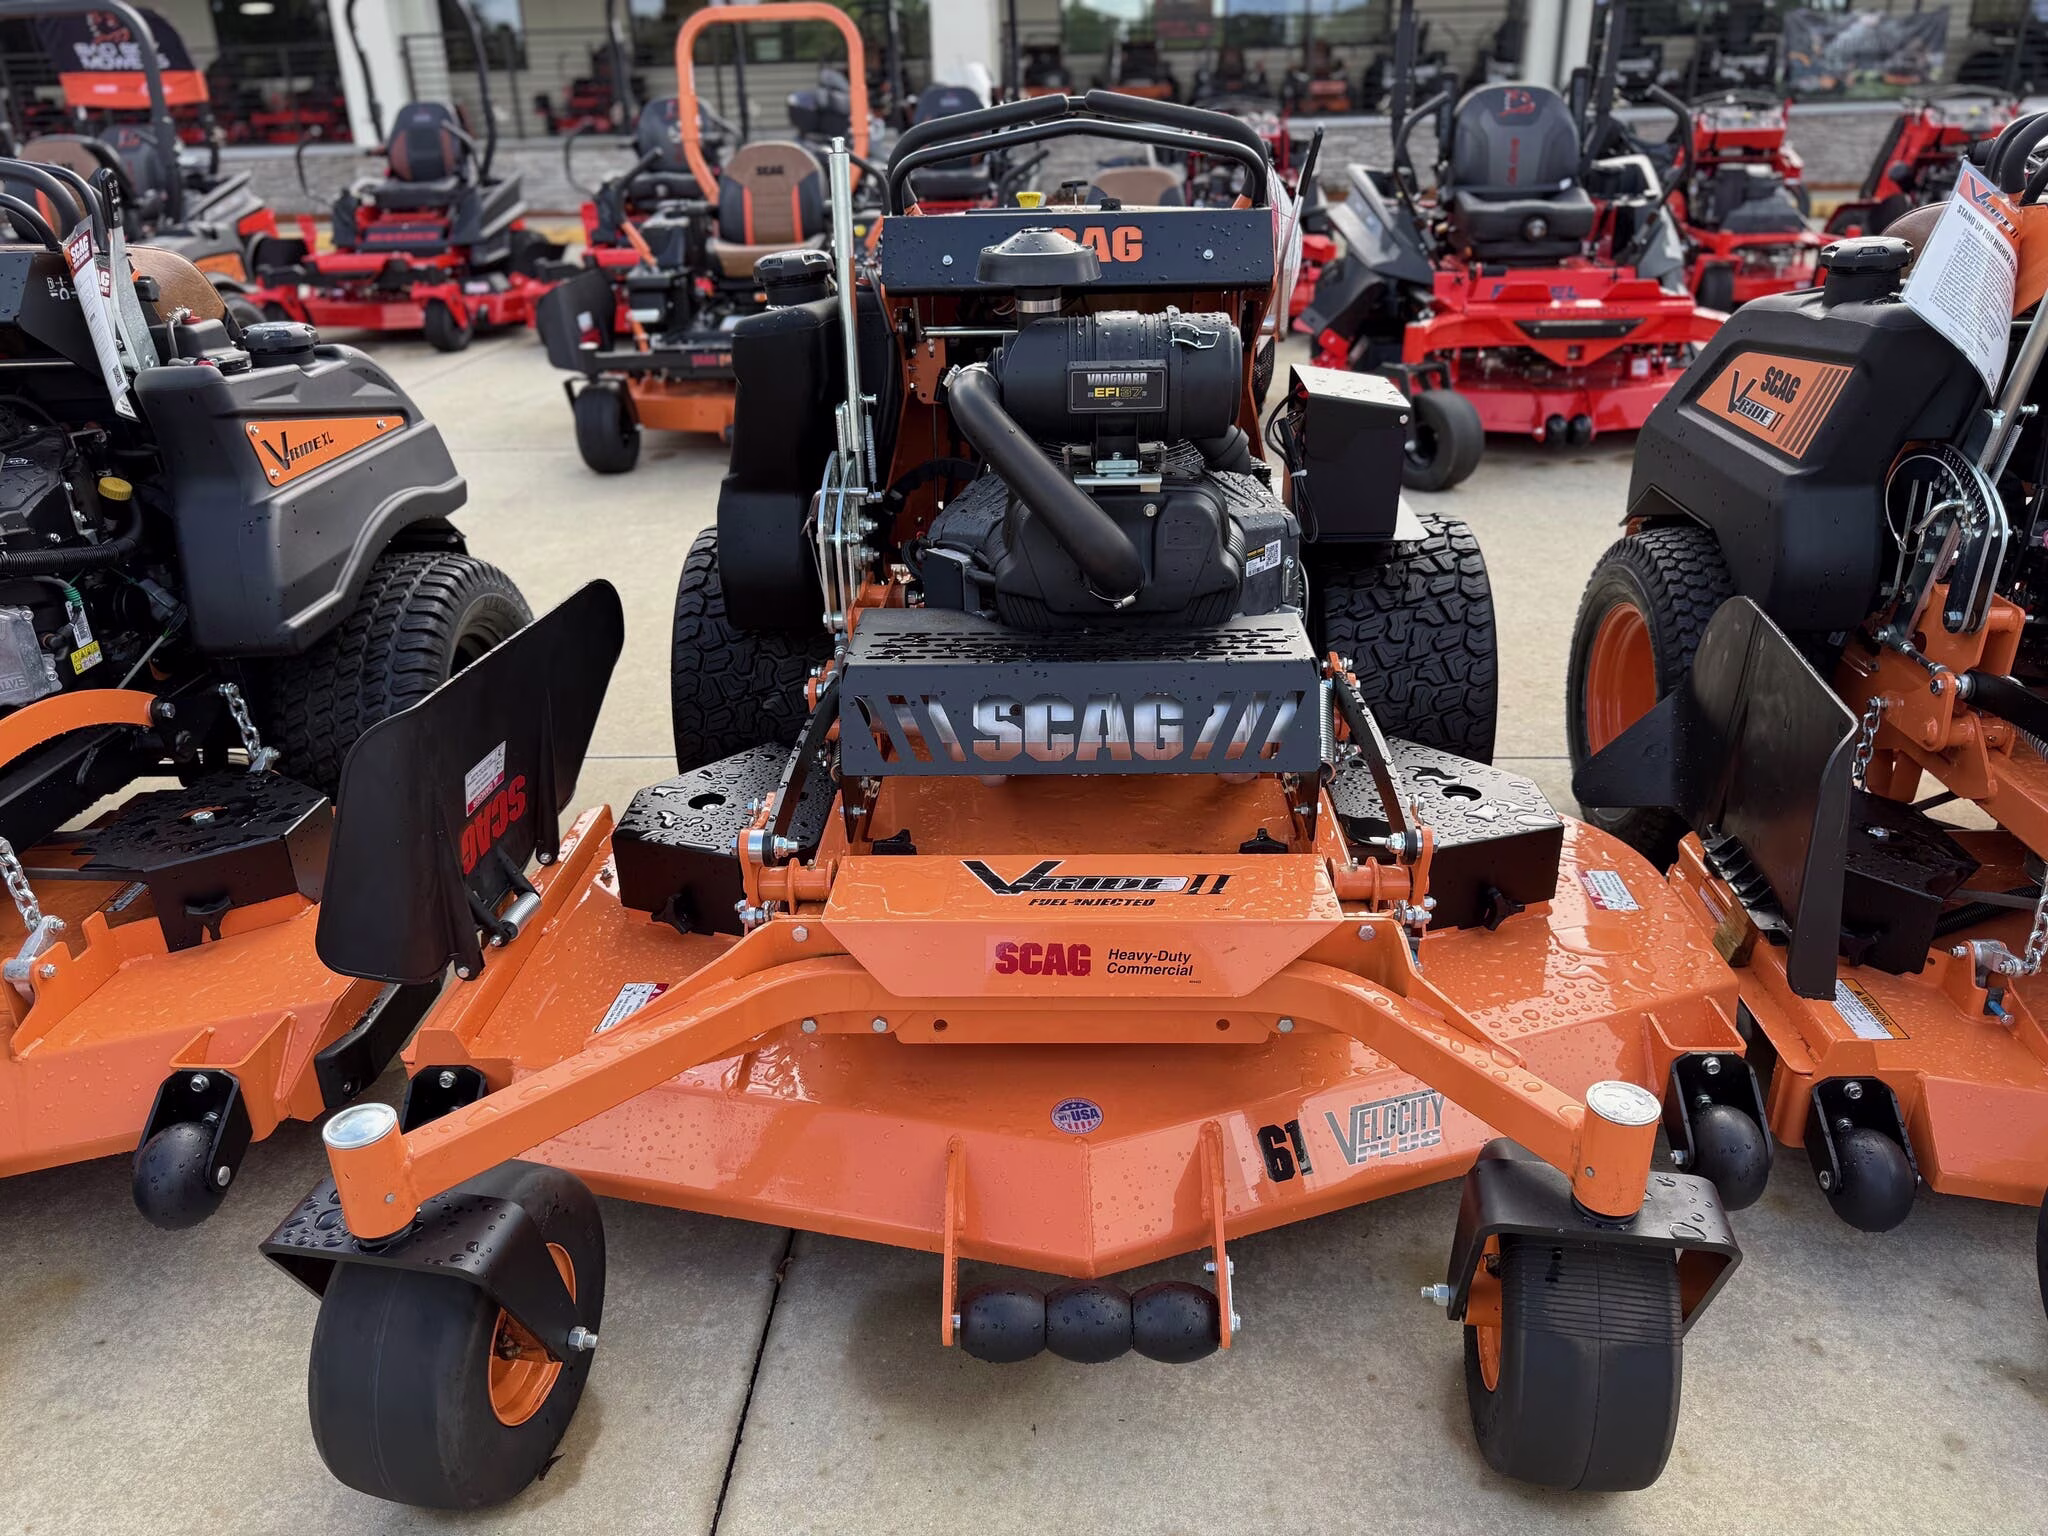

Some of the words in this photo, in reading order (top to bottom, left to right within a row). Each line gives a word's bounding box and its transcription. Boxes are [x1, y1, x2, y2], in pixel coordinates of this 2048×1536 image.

[70, 235, 89, 264] SCAG
[1052, 226, 1143, 263] AG
[1957, 204, 1975, 226] STAND
[1975, 221, 1984, 233] UP
[1993, 239, 2011, 263] HIGHER
[1087, 372, 1148, 386] VANGUARD
[1760, 366, 1801, 404] SCAG
[1767, 411, 1786, 432] II
[322, 431, 335, 446] XL
[972, 694, 1184, 762] SCAG
[461, 774, 527, 875] SCAG
[1180, 873, 1237, 896] II
[1028, 898, 1156, 907] FUEL-INJECTED
[995, 941, 1092, 977] SCAG
[1106, 962, 1194, 977] Commercial
[1107, 948, 1192, 966] Heavy-Duty
[1861, 995, 1893, 1027] WARNING
[1070, 1107, 1100, 1121] USA
[1323, 1088, 1446, 1166] VELOCITY
[1256, 1118, 1314, 1183] 61
[1357, 1128, 1442, 1164] PLUS
